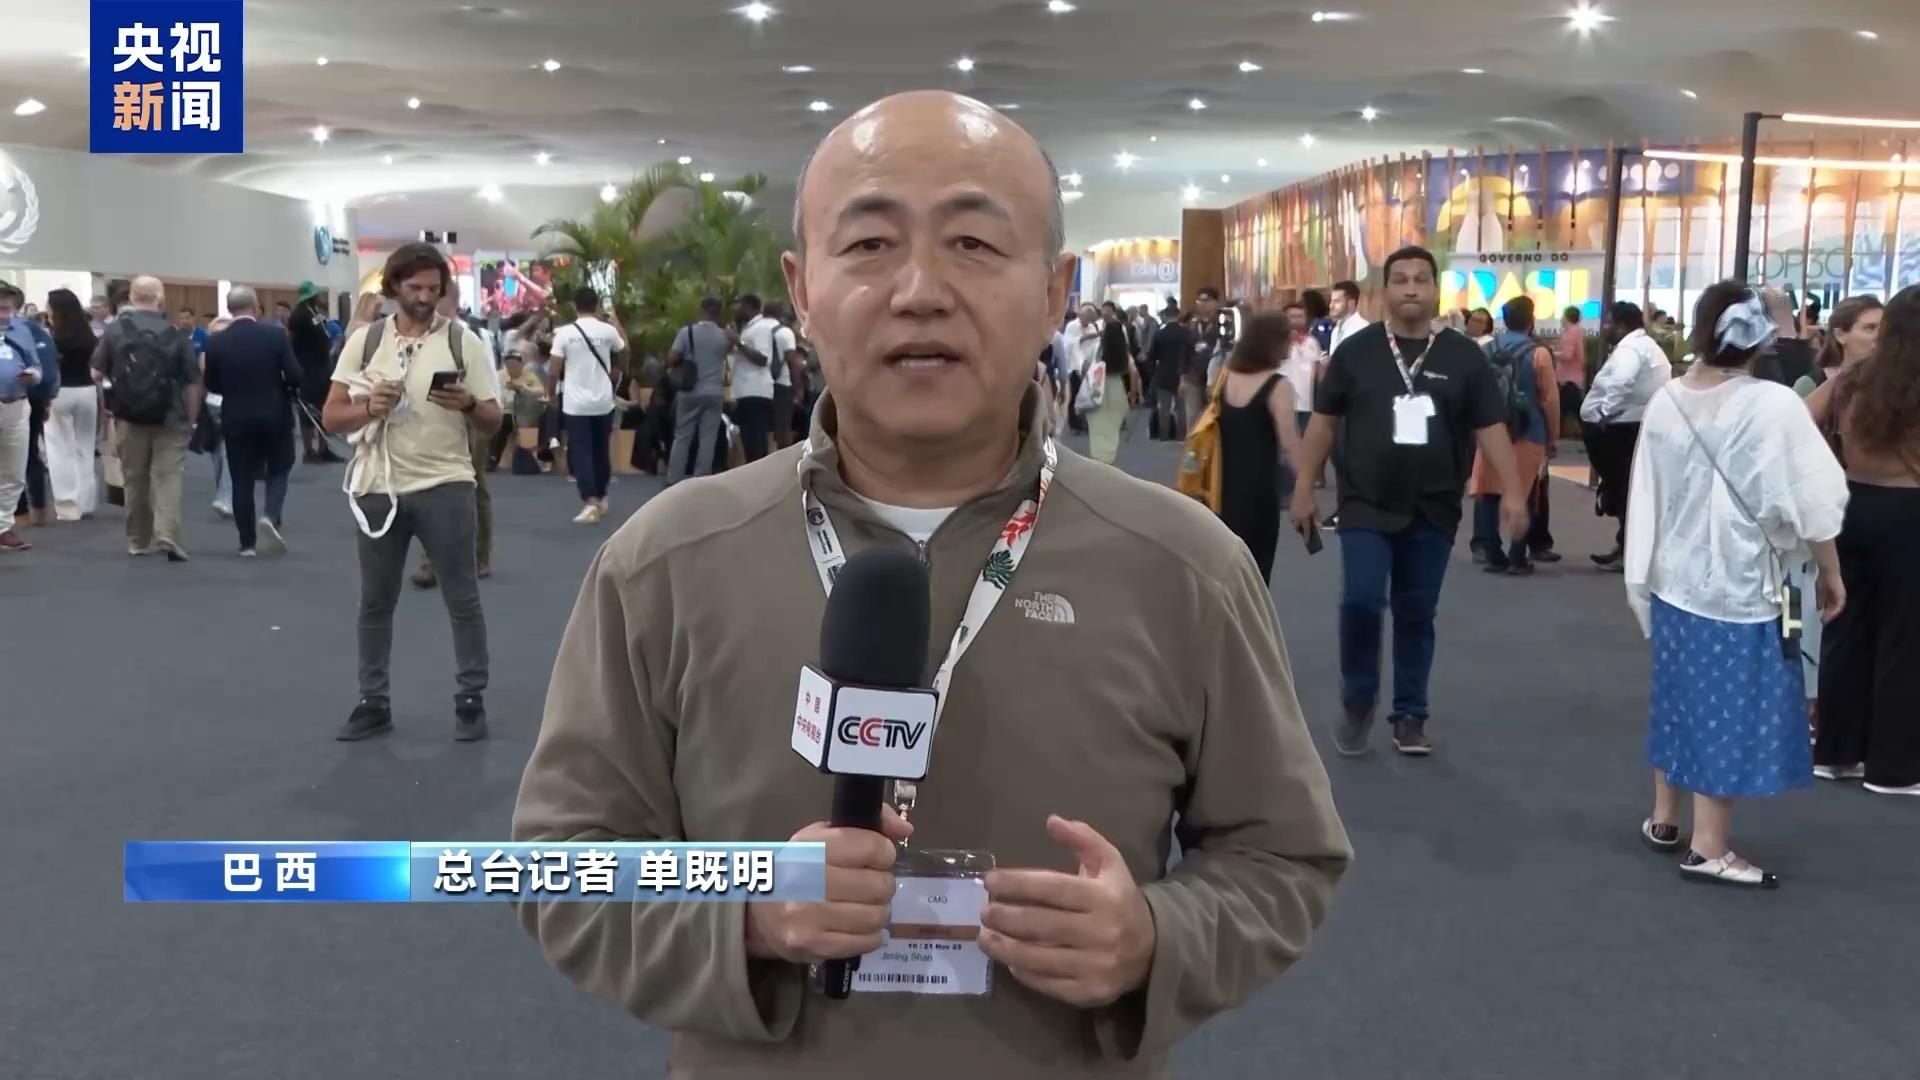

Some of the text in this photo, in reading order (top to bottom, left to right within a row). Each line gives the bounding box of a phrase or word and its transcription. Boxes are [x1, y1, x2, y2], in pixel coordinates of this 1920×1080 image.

[1479, 253, 1569, 263] GOVERNO DO
[1033, 591, 1054, 602] THE
[1015, 598, 1054, 613] NORTH
[1025, 608, 1054, 622] FACE
[837, 716, 927, 750] CCTV
[881, 952, 934, 962] Jiming Shan
